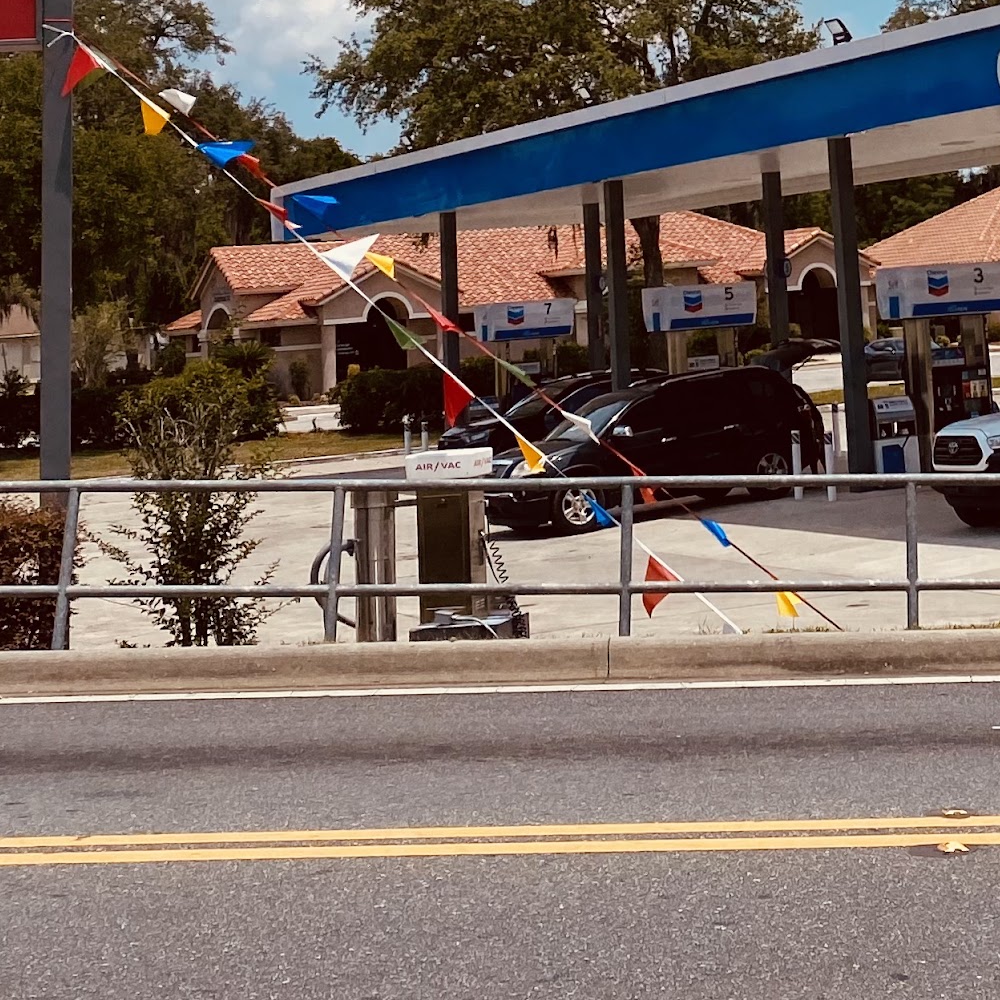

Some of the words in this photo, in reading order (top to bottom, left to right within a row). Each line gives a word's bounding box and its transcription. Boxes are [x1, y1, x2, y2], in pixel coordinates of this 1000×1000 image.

[973, 267, 984, 284] 3
[724, 286, 734, 301] 5
[543, 302, 552, 315] 7
[415, 461, 462, 472] AIR/VAC
